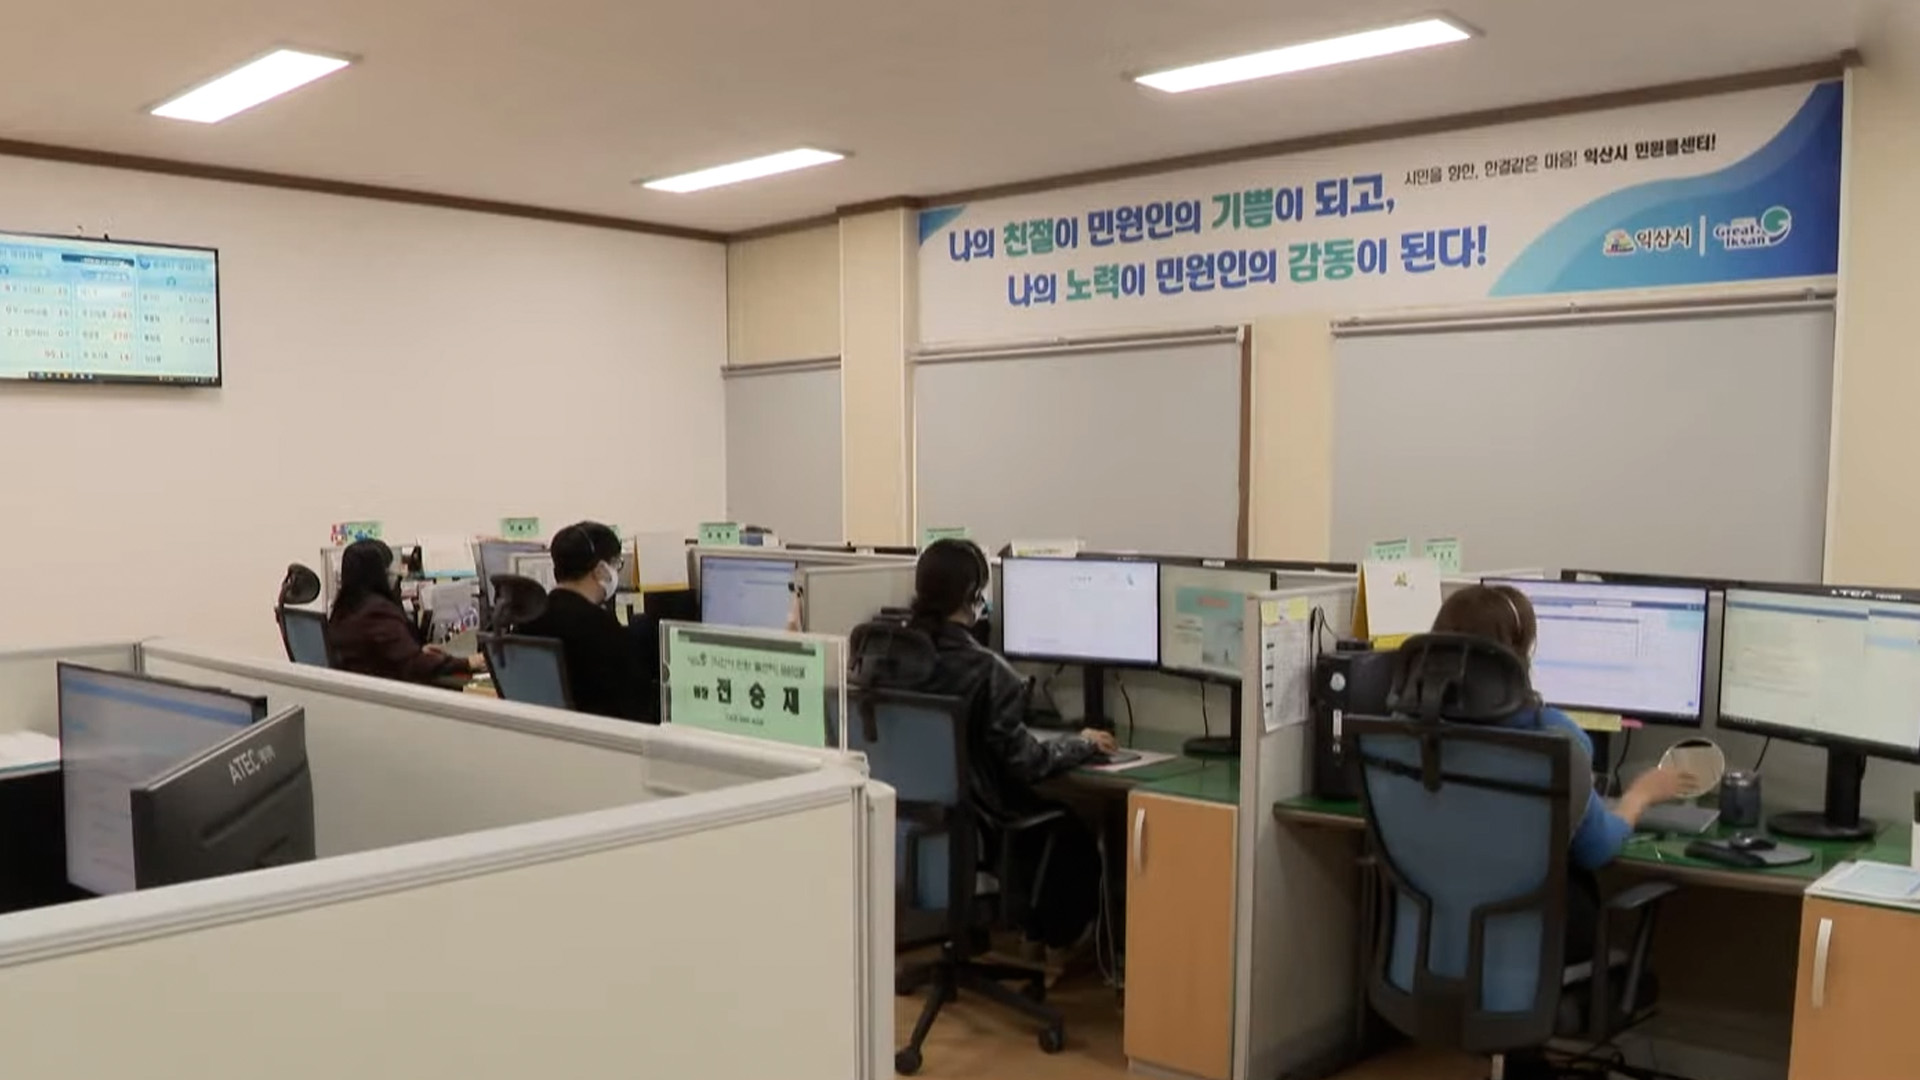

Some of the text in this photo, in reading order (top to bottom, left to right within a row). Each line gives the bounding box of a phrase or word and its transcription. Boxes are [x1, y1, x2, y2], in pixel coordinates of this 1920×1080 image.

[1404, 166, 1442, 186] 시민을
[1484, 154, 1538, 178] 한결같은
[1583, 143, 1628, 166] 익산시
[1635, 132, 1717, 160] 민원콜센터!
[949, 172, 1395, 262] 나의 친절이 민원인의 기쁨이 되고,
[1635, 225, 1693, 250] 익산시
[1008, 224, 1487, 307] 나의 노력이 민원인의 감동이 된다!
[229, 749, 260, 786] ATEC
